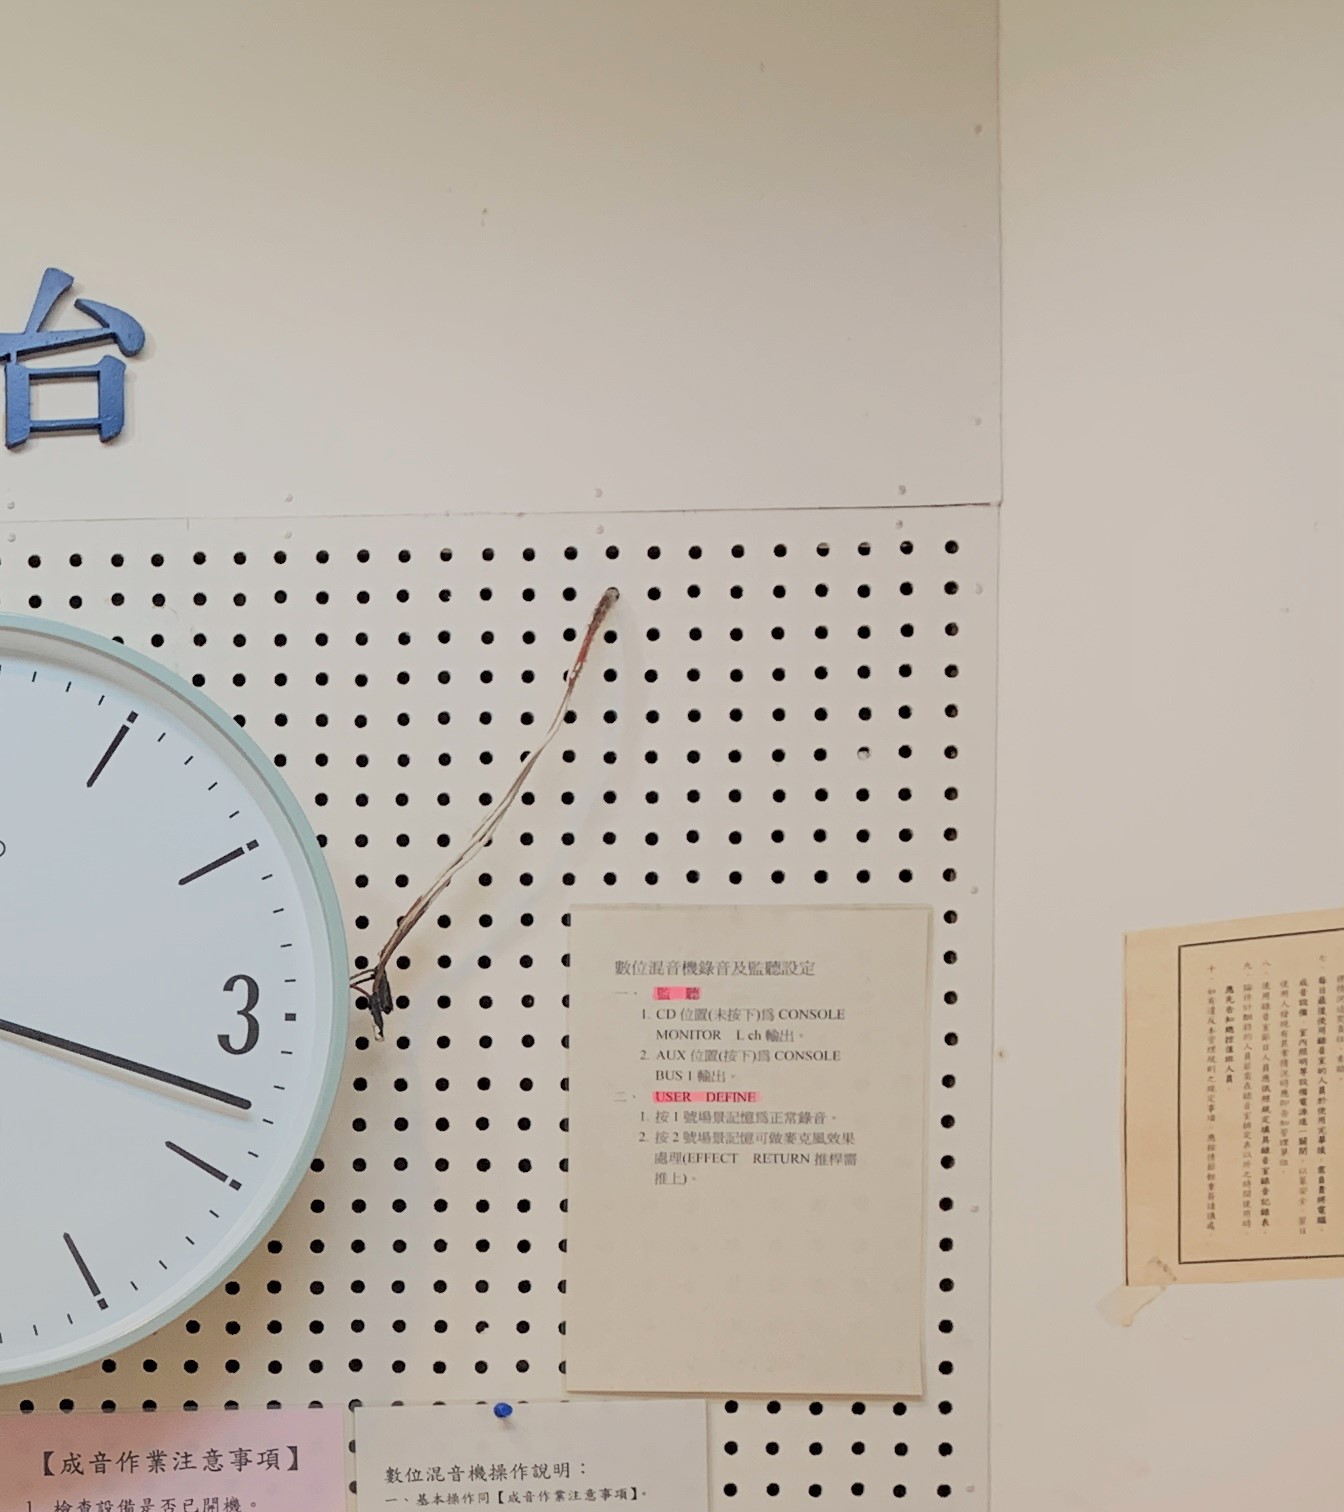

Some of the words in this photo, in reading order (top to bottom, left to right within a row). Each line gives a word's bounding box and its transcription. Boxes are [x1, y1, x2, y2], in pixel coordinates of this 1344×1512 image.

[615, 960, 815, 977] 數位混音機錄音及監聽設定
[217, 975, 260, 1055] 3
[656, 1009, 676, 1020] CD
[778, 1009, 845, 1020] CONSOLE
[656, 1030, 722, 1041] MONITOR
[736, 1030, 744, 1041] L
[748, 1029, 762, 1041] ch
[656, 1050, 686, 1061] AUX
[774, 1050, 841, 1061] CONSOLE
[656, 1070, 683, 1081] BUS
[656, 1092, 691, 1102] USER
[706, 1092, 756, 1102] DEFINE
[753, 1152, 810, 1164] RETURN
[42, 1445, 299, 1477] 【成音作業注意事項】
[384, 1462, 586, 1483] 數位混音機操作說明：
